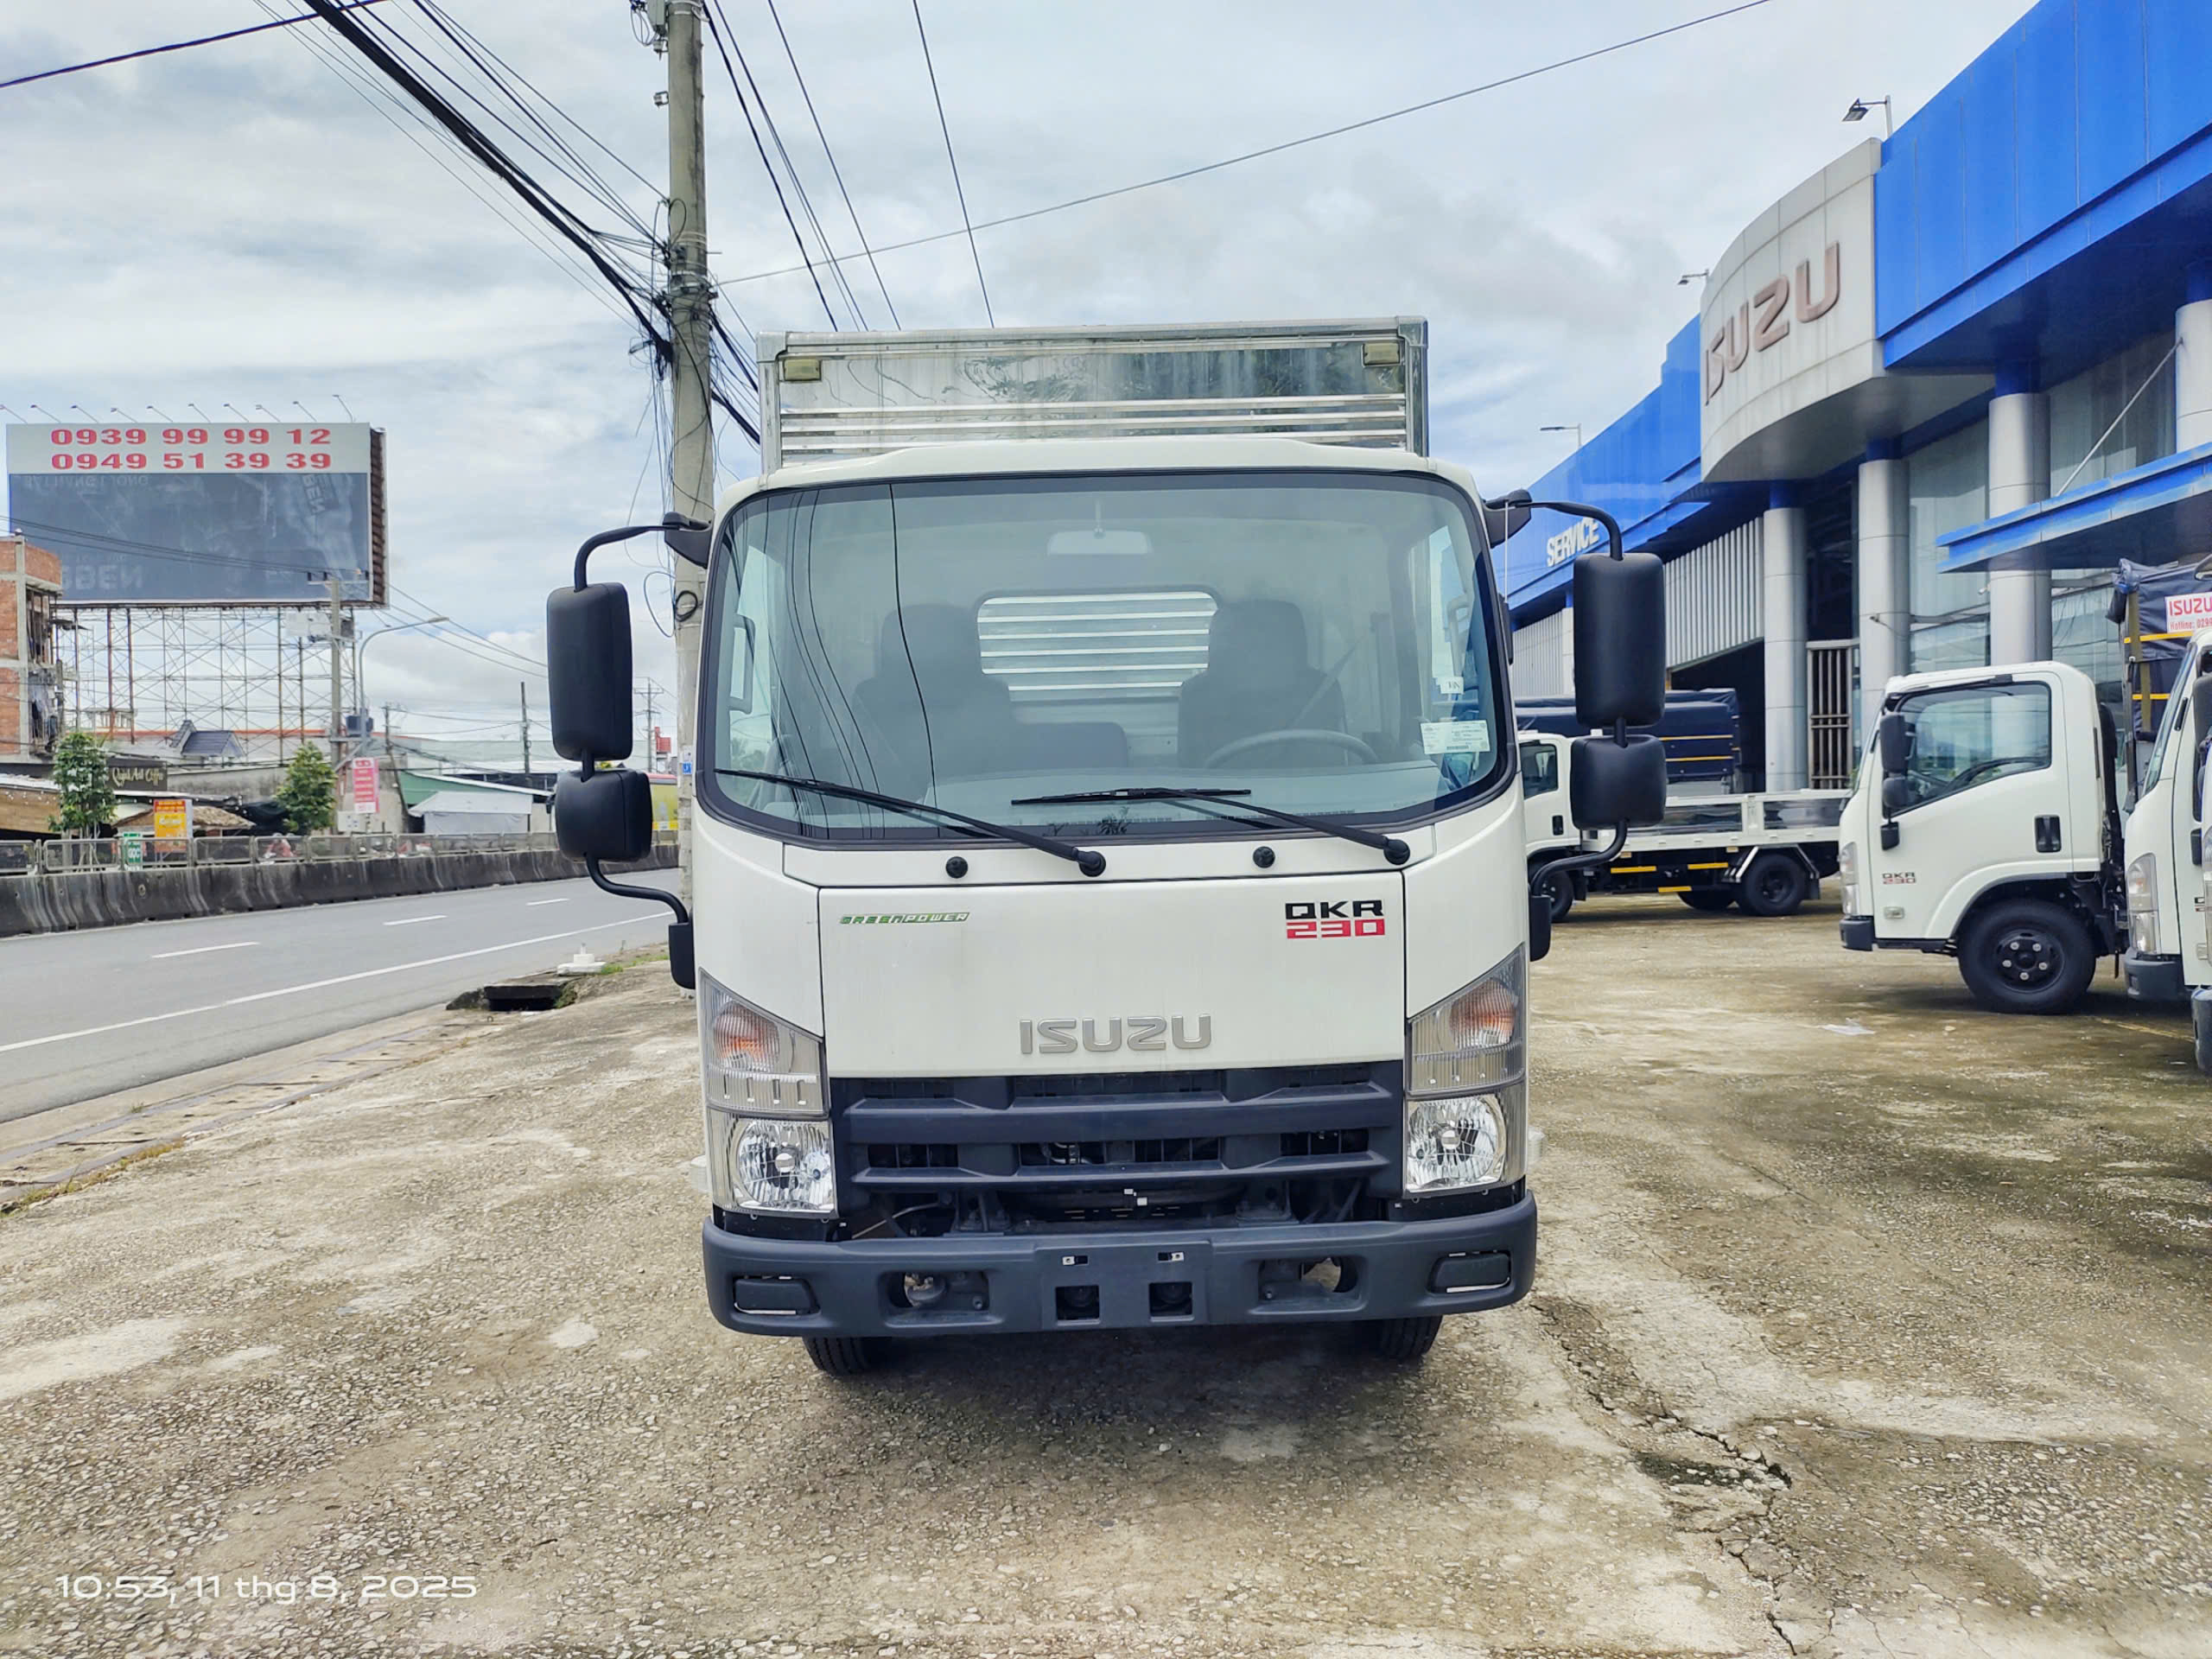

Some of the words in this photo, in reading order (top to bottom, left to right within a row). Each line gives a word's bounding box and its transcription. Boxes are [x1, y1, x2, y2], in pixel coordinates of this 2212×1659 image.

[1705, 241, 1841, 406] ISUZU
[51, 429, 146, 445] 0939
[162, 429, 208, 444] 99
[223, 429, 270, 444] 99
[286, 429, 332, 444] 12
[51, 454, 147, 469] 0949
[163, 453, 204, 469] 51
[225, 453, 270, 469] 39
[286, 453, 332, 469] 39
[1547, 517, 1599, 567] SERVICE
[2169, 597, 2212, 616] ISUZU
[1285, 899, 1384, 919] QKR
[1287, 918, 1385, 938] 230
[1020, 1013, 1211, 1054] ISUZU
